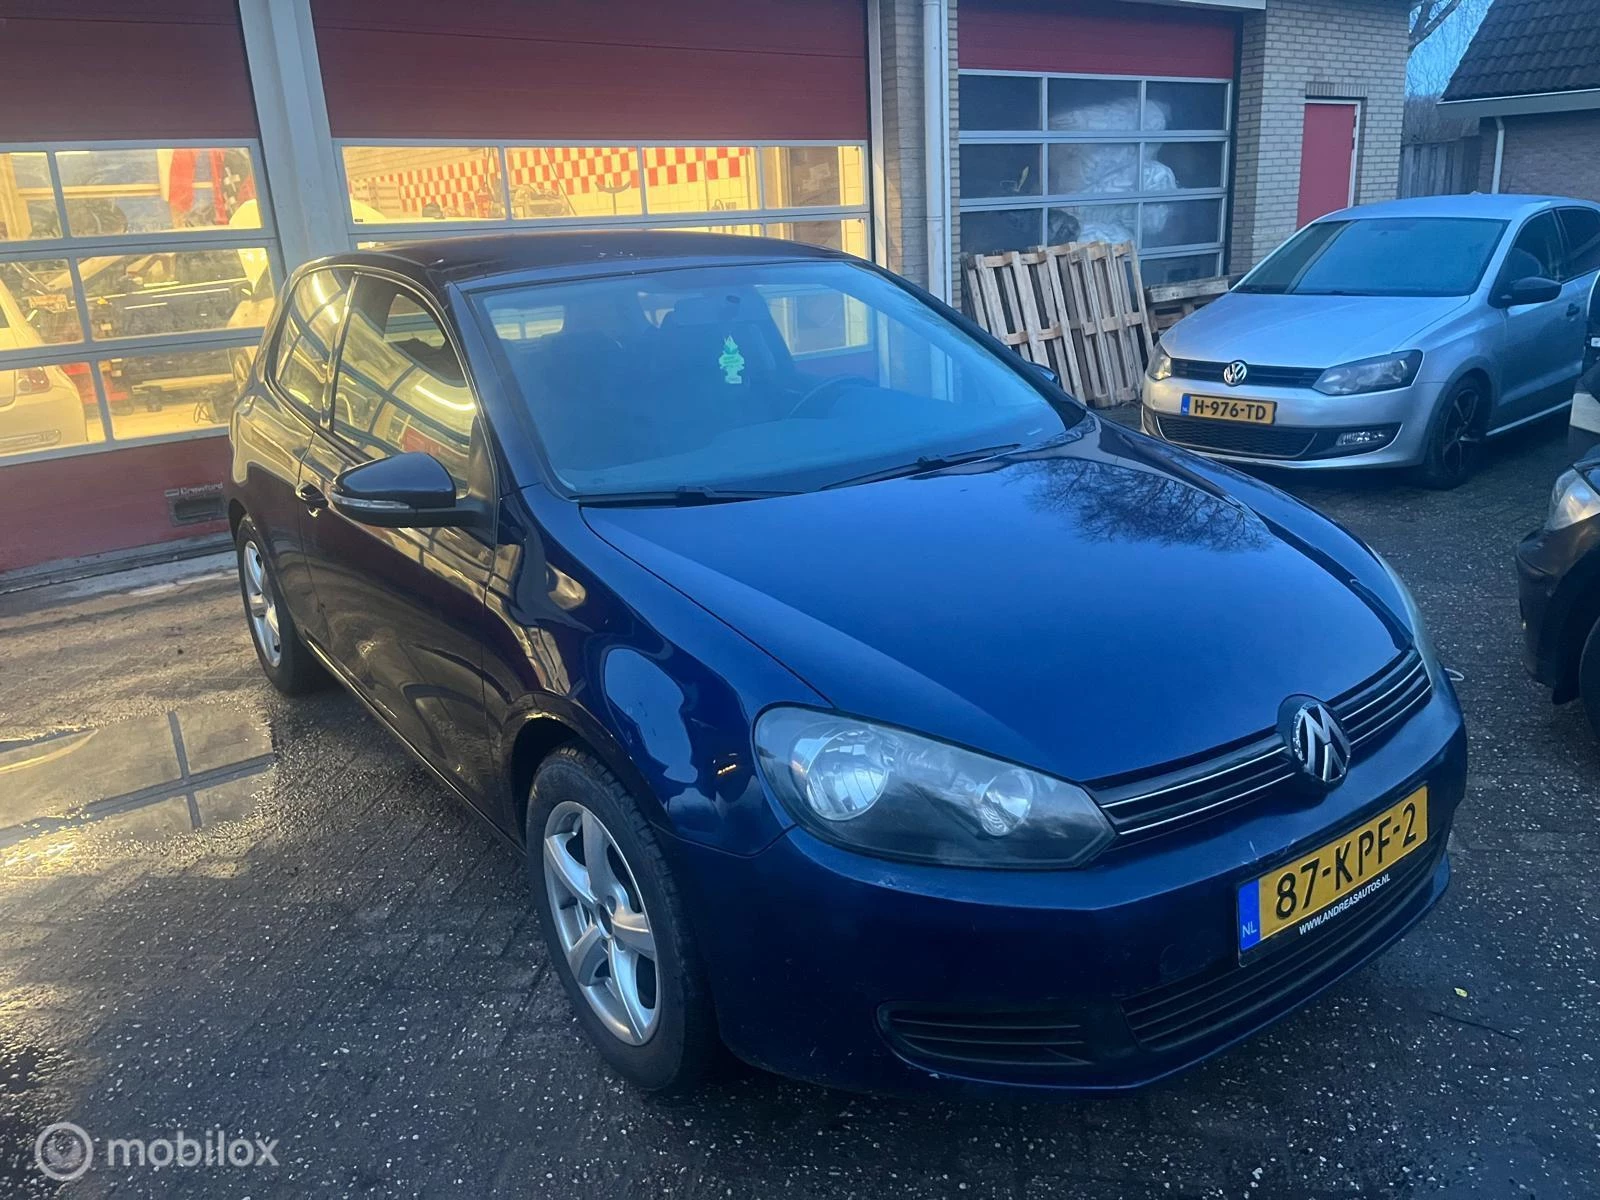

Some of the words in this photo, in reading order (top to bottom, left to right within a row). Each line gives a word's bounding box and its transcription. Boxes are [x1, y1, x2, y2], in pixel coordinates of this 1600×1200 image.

[1194, 399, 1267, 420] H-976-TD
[1242, 922, 1257, 938] NL
[1275, 802, 1417, 920] 87-KPF-2
[1299, 873, 1391, 936] WWW.ANDREASAUTOS.NL
